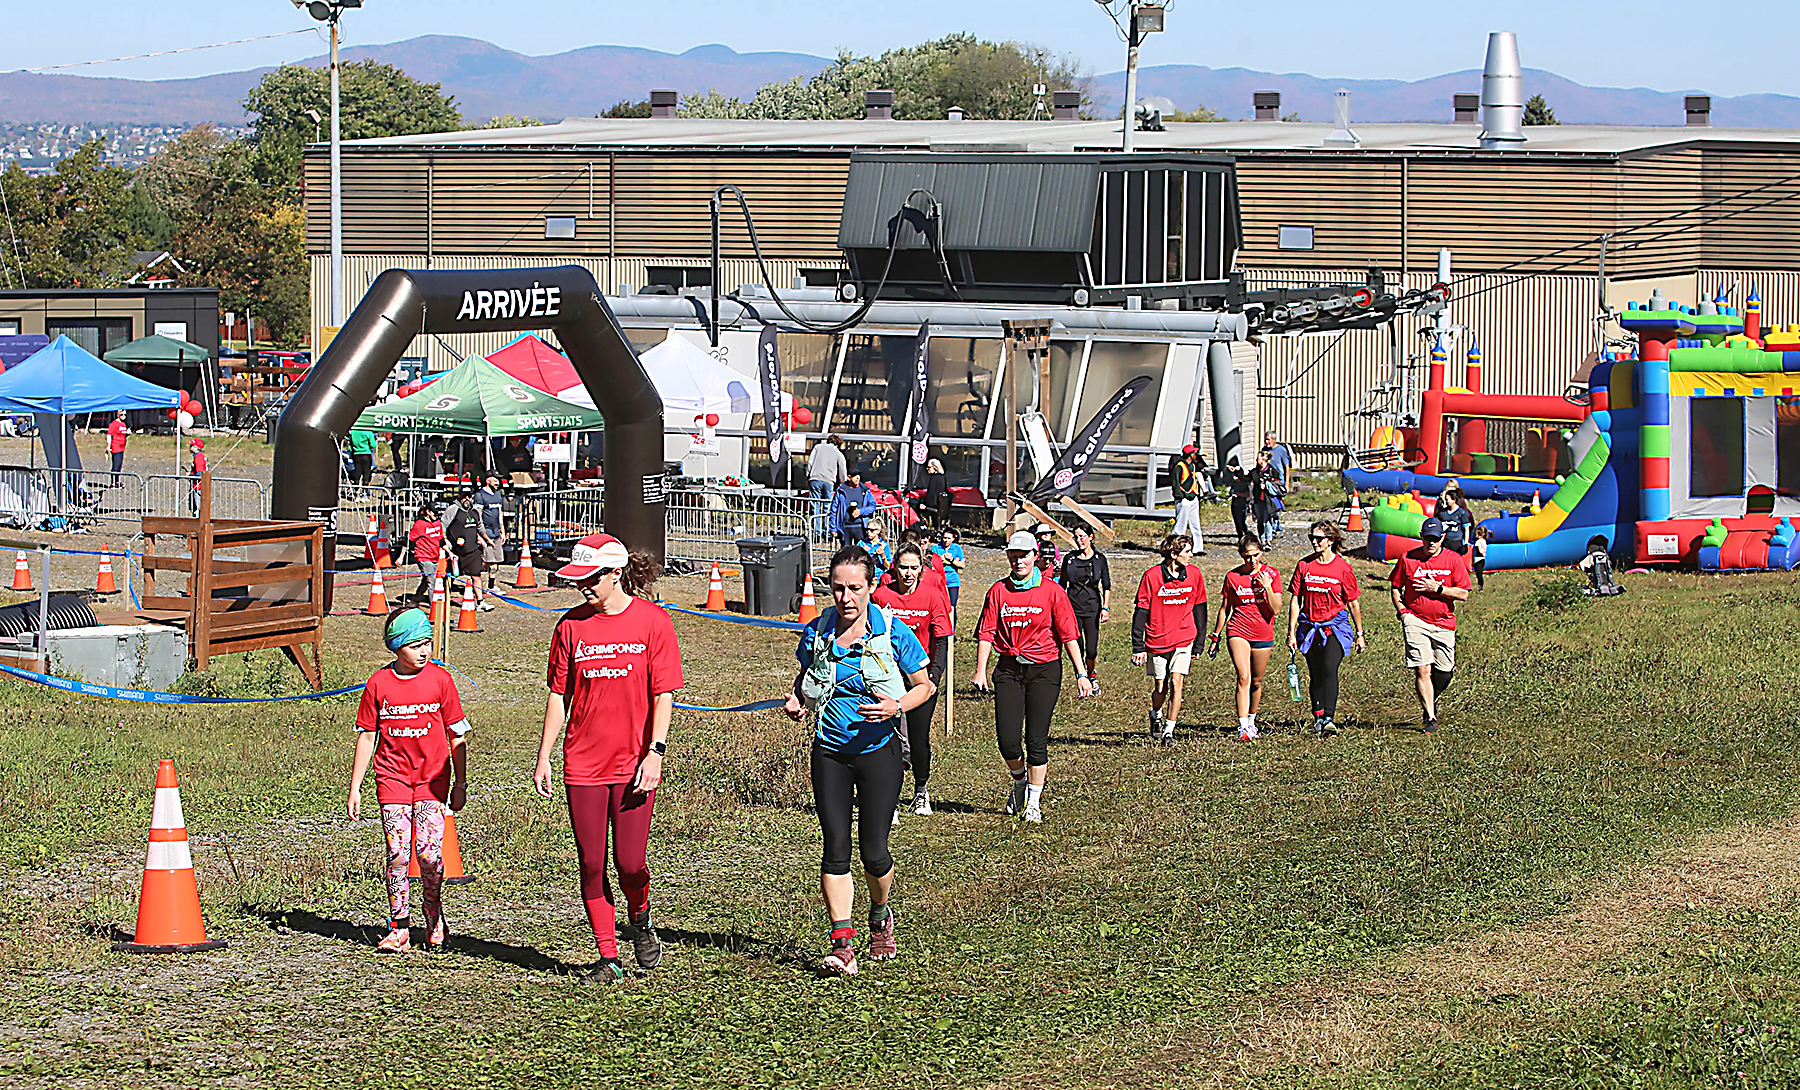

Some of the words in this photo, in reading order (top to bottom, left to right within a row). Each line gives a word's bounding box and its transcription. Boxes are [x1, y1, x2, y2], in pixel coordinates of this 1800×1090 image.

[456, 281, 560, 320] ARRIVÉE
[516, 415, 583, 430] SPORTSTATS
[585, 643, 647, 656] GRIMPONSP
[583, 666, 628, 679] Latulippe
[46, 676, 72, 690] SHIMANO
[81, 684, 108, 696] SHIMANO
[117, 689, 145, 700] SHIMANO
[388, 702, 441, 715] GRIMPONSP
